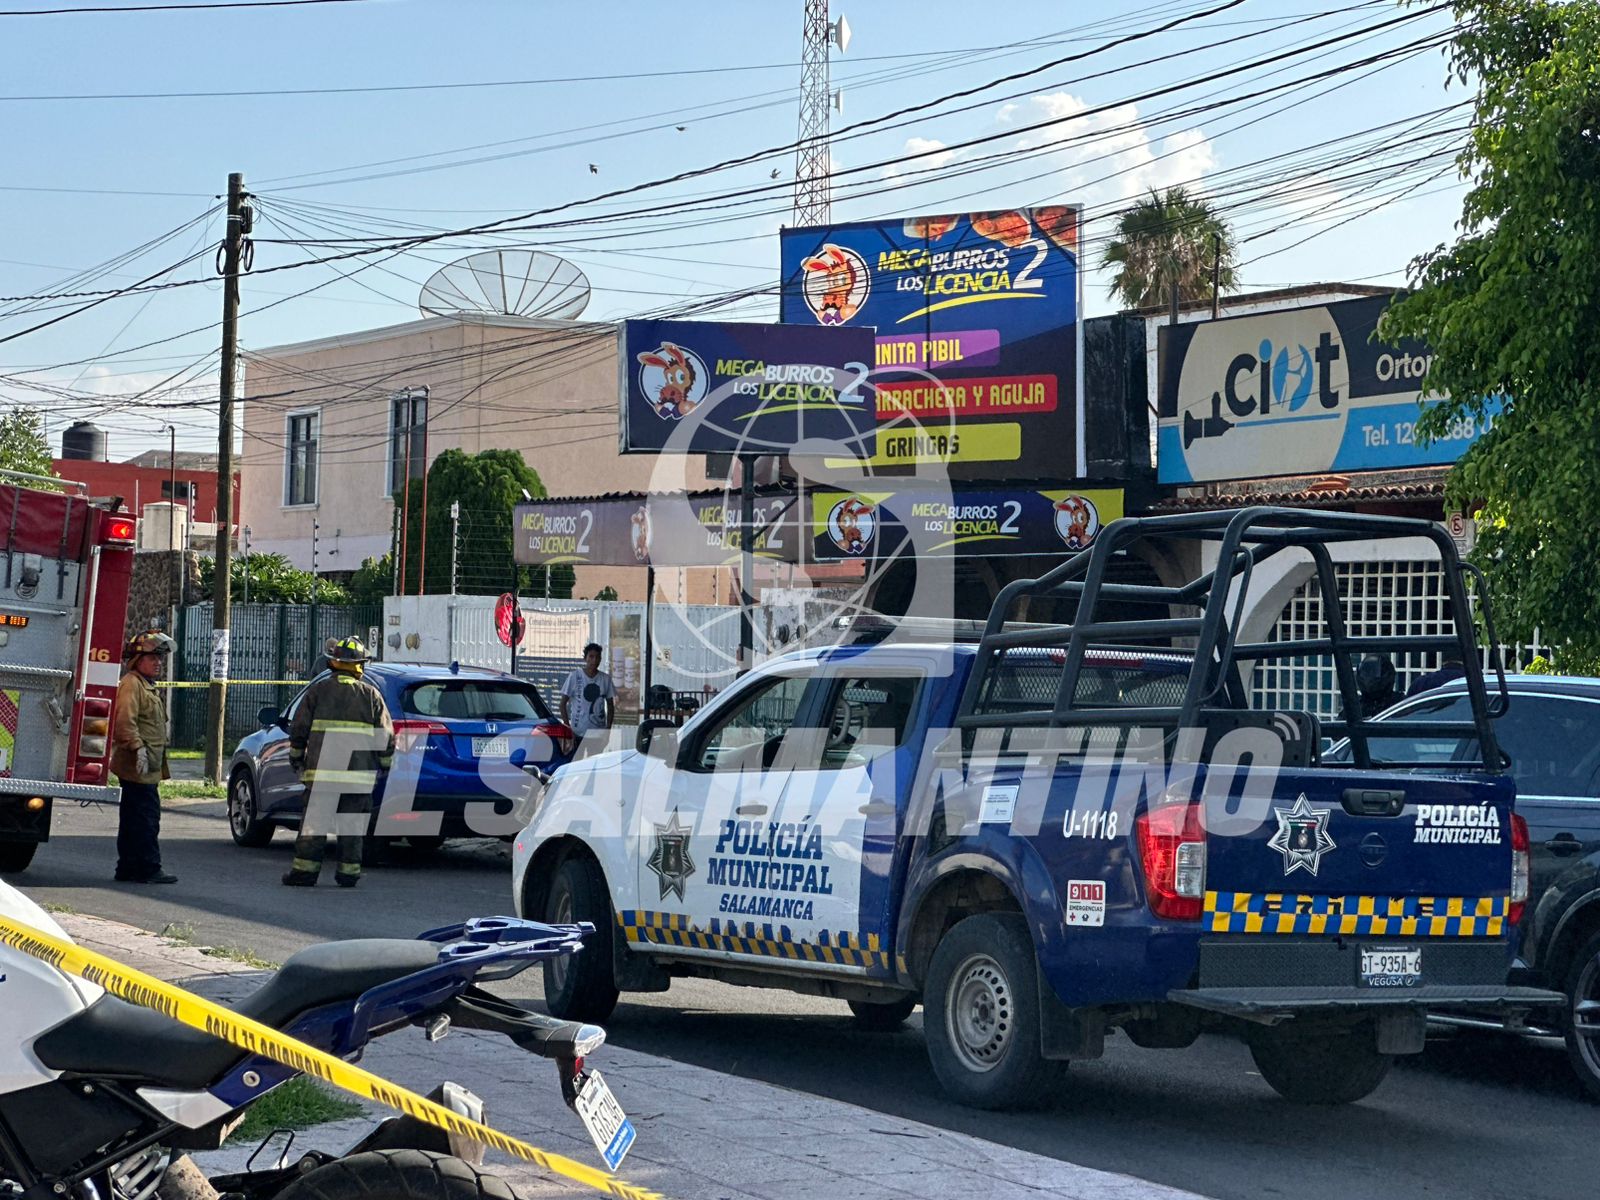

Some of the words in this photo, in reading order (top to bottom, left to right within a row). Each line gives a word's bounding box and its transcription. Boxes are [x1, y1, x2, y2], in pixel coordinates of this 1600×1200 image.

[1013, 237, 1049, 290] 2
[922, 338, 964, 362] PIBIL
[733, 382, 758, 395] LOS
[758, 383, 835, 402] LICENCIA
[838, 361, 870, 403] 2
[973, 386, 983, 407] Y
[990, 382, 1045, 406] AGUJA
[886, 434, 960, 457] GRINGAS
[1362, 423, 1390, 447] Tel.
[766, 499, 787, 549] 2
[924, 520, 943, 531] LOS
[943, 520, 999, 534] LICENCIA
[1000, 500, 1022, 533] 2
[576, 509, 594, 553] 2
[1063, 809, 1118, 840] U-1118
[1415, 801, 1500, 827] POLICÍA
[715, 815, 823, 860] POLICÍA
[1413, 827, 1502, 844] MUNICIPAL
[707, 858, 833, 895] MUNICIPAL
[1071, 885, 1102, 899] 911
[719, 893, 814, 921] SALAMANCA
[1069, 904, 1103, 912] EMERGENCIAS
[1361, 955, 1421, 973] GT-935A-6
